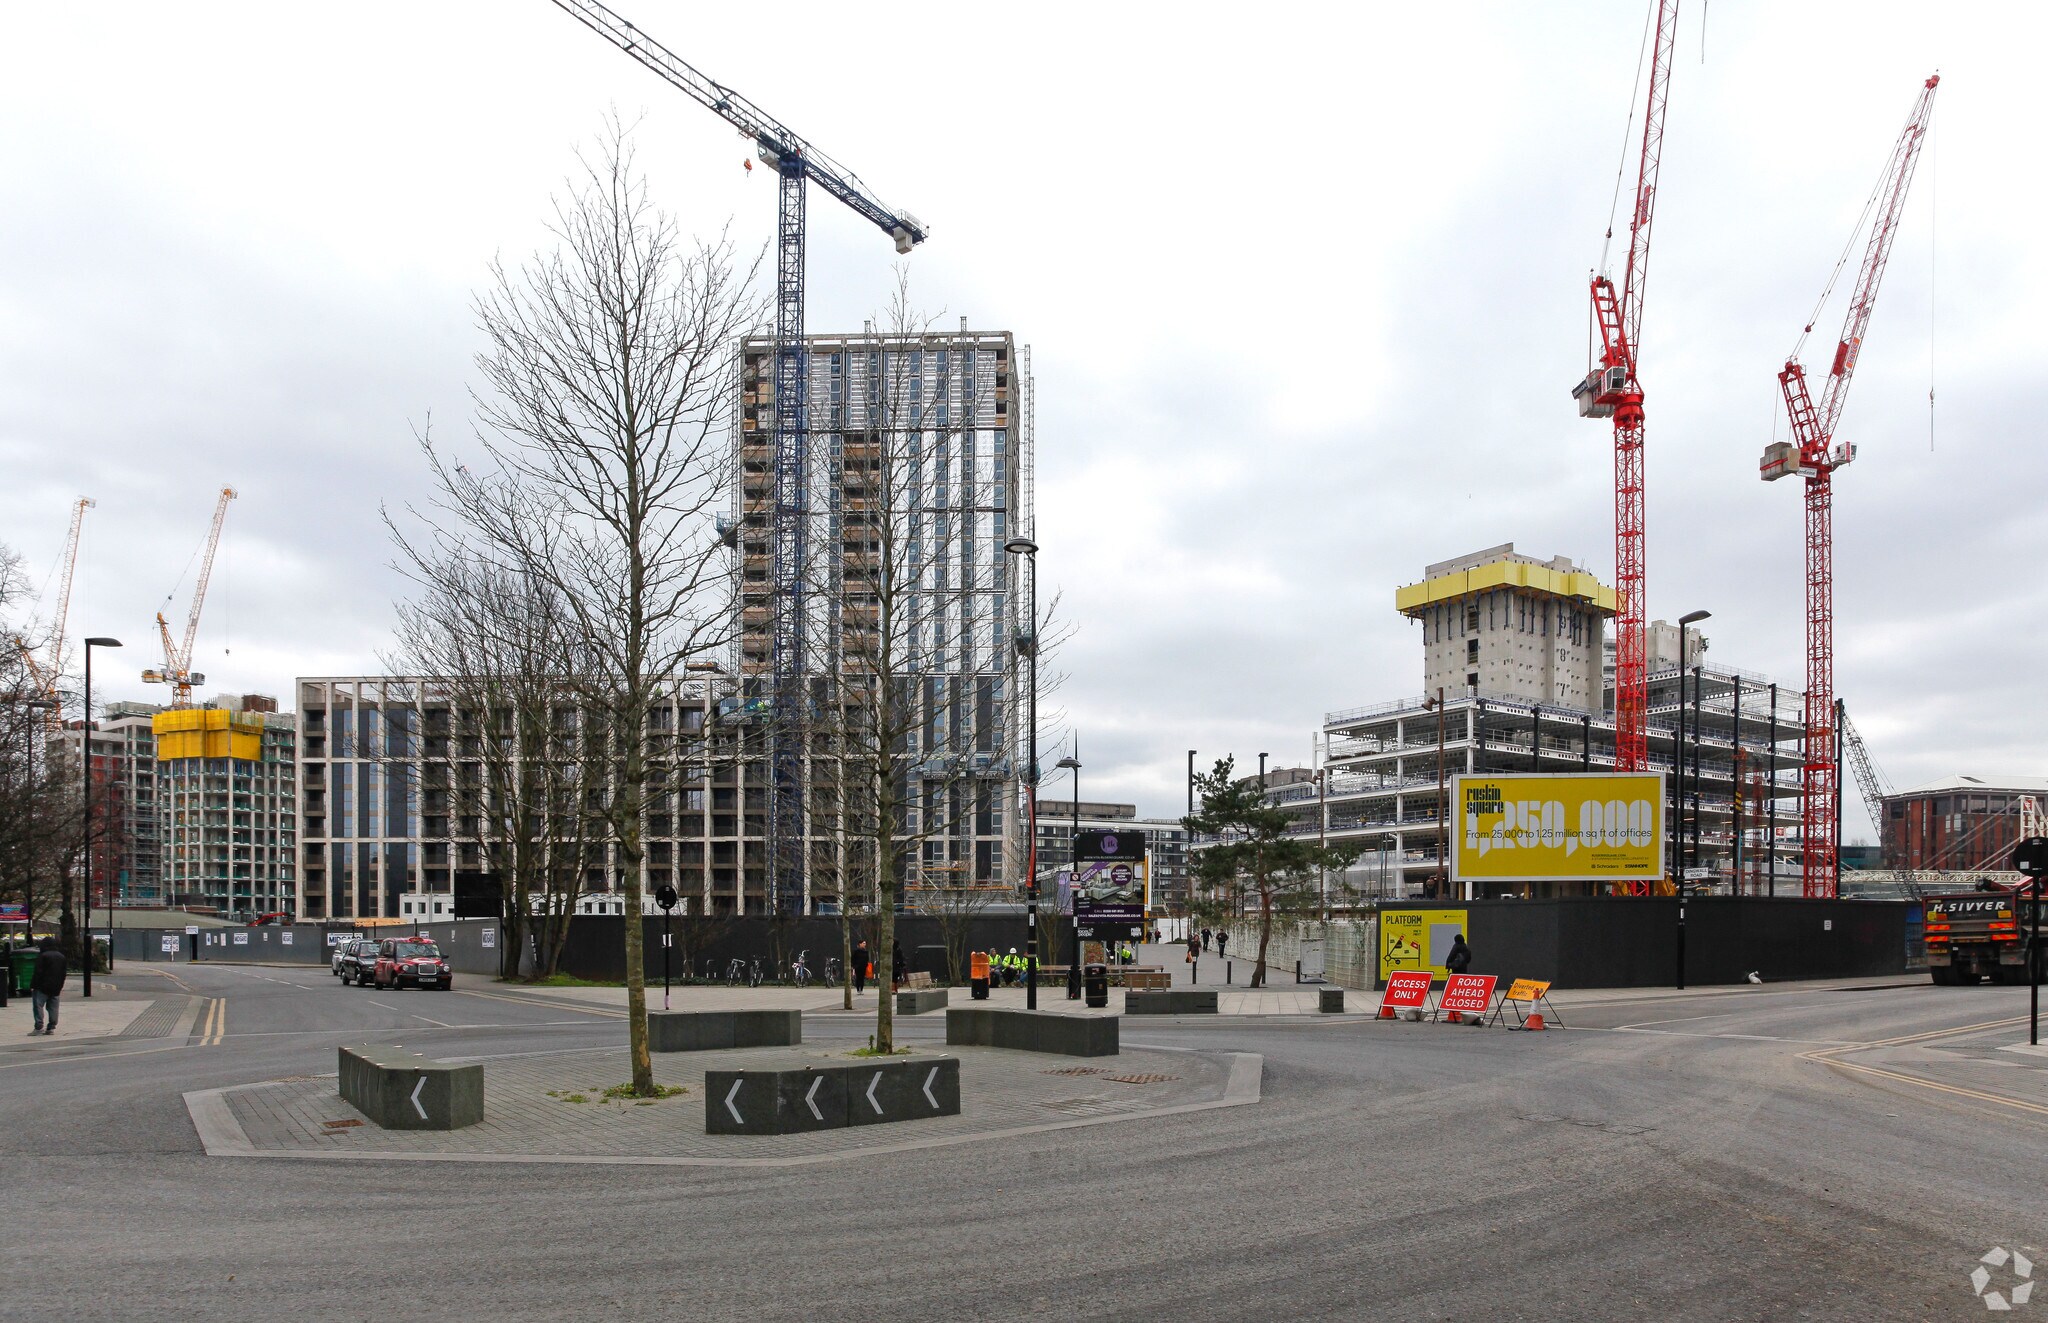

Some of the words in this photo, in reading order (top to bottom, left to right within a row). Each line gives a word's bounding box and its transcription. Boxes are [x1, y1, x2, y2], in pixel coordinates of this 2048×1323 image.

[1560, 648, 1566, 662] 8
[1560, 683, 1566, 696] 7
[1466, 784, 1501, 800] ruskin
[1466, 801, 1504, 818] square
[1466, 829, 1489, 839] From
[1491, 829, 1523, 840] 25,000
[1525, 830, 1534, 838] to
[1555, 829, 1584, 838] million
[1586, 830, 1597, 839] sq
[1599, 828, 1606, 837] ft
[1608, 828, 1618, 837] of
[1620, 828, 1652, 837] offices
[1933, 901, 2005, 912] H.SIVYER
[1386, 915, 1422, 925] PLATFORM
[1392, 979, 1427, 988] ACCESS
[1457, 978, 1485, 987] ROAD
[1513, 982, 1535, 991] Diverted
[1394, 990, 1418, 999] ONLY
[1451, 988, 1485, 997] AHEAD
[1445, 998, 1484, 1008] CLOSED
